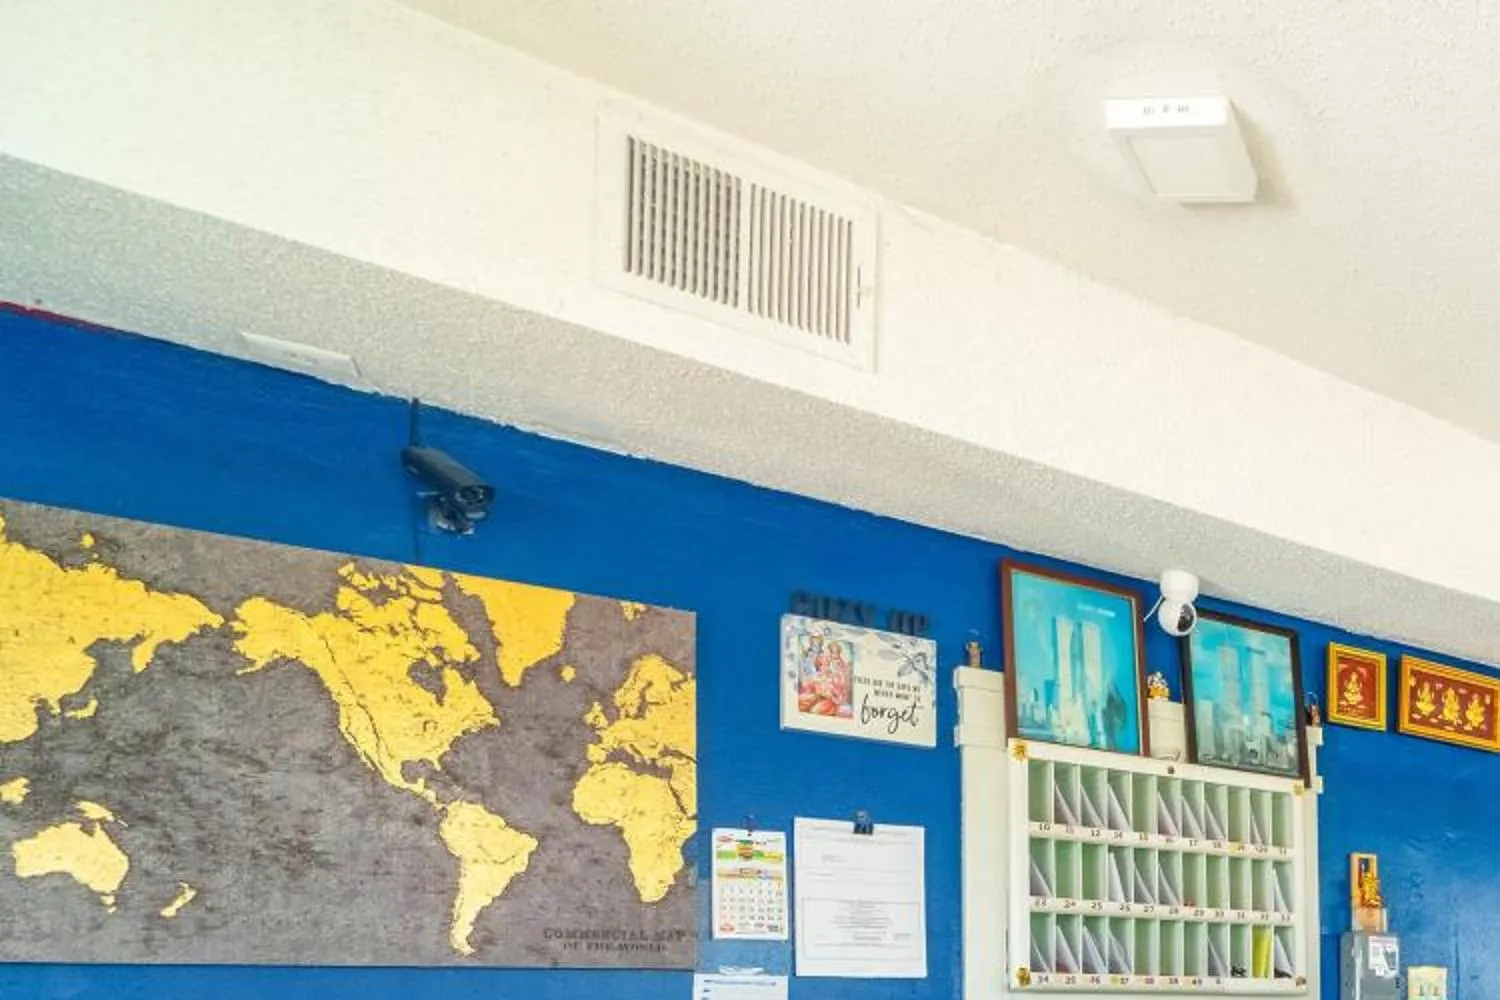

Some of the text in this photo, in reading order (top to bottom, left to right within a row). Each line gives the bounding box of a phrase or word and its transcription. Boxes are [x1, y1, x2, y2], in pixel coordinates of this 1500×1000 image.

[861, 693, 922, 734] forget
[543, 927, 687, 942] COMMERCIAL MAP
